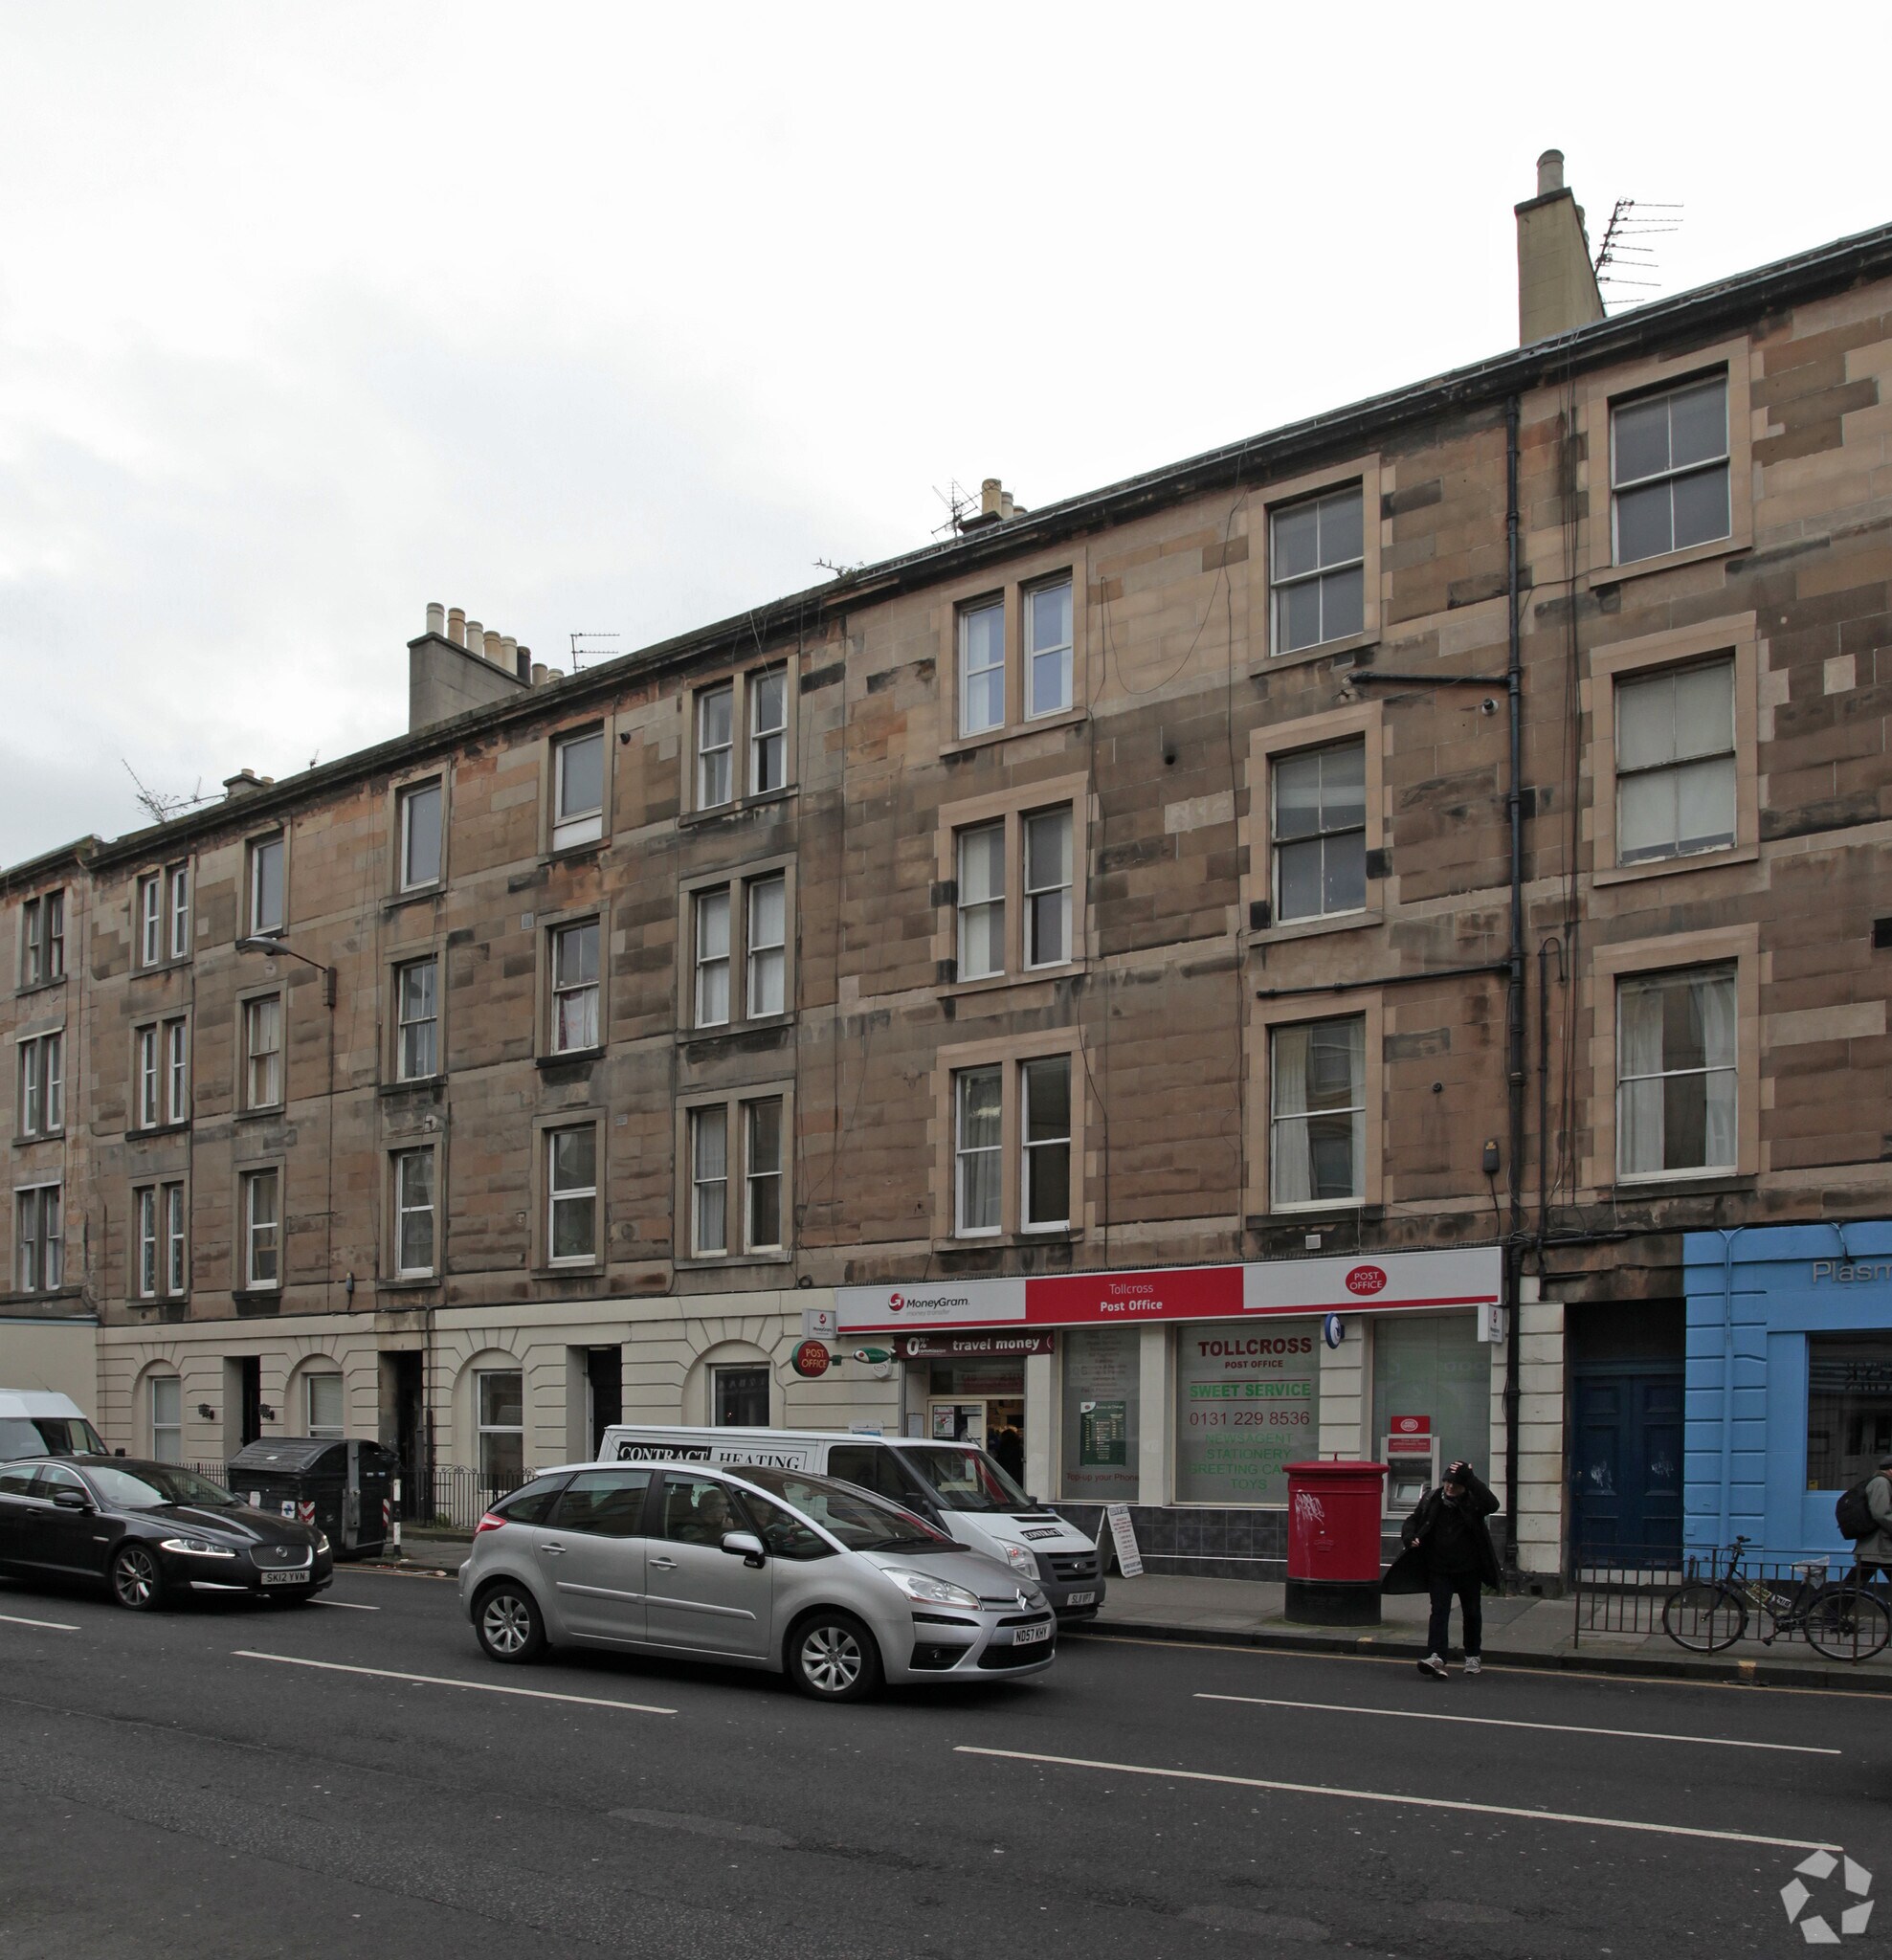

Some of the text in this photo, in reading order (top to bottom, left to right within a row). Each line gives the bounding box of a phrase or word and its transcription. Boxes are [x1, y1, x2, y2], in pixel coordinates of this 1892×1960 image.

[1354, 1271, 1379, 1281] POST
[1108, 1283, 1154, 1295] Tollcross
[1349, 1280, 1383, 1290] OFFICE
[906, 1297, 968, 1309] MoneyGram
[1101, 1300, 1163, 1312] Post Office
[952, 1339, 991, 1351] travel
[995, 1338, 1040, 1351] money
[1198, 1337, 1312, 1356] TOLLCROSS
[805, 1348, 824, 1358] POST
[801, 1359, 827, 1369] OFFICE
[1251, 1360, 1283, 1369] OFFICE
[1190, 1384, 1311, 1397] SWEET SERVICE
[1190, 1412, 1309, 1425] 0131 229 8536
[1206, 1434, 1294, 1444] NEWSAGENT
[619, 1446, 799, 1468] CONTRACT HEATING
[1207, 1448, 1292, 1459] STATIONERY
[1189, 1463, 1258, 1475] GREETING
[1066, 1473, 1092, 1482] Top-up
[1095, 1474, 1113, 1482] your
[1232, 1479, 1268, 1490] TOYS
[1023, 1529, 1061, 1539] CONTRACT
[267, 1572, 305, 1582] SK12 YVN
[1015, 1629, 1035, 1642] ND57
